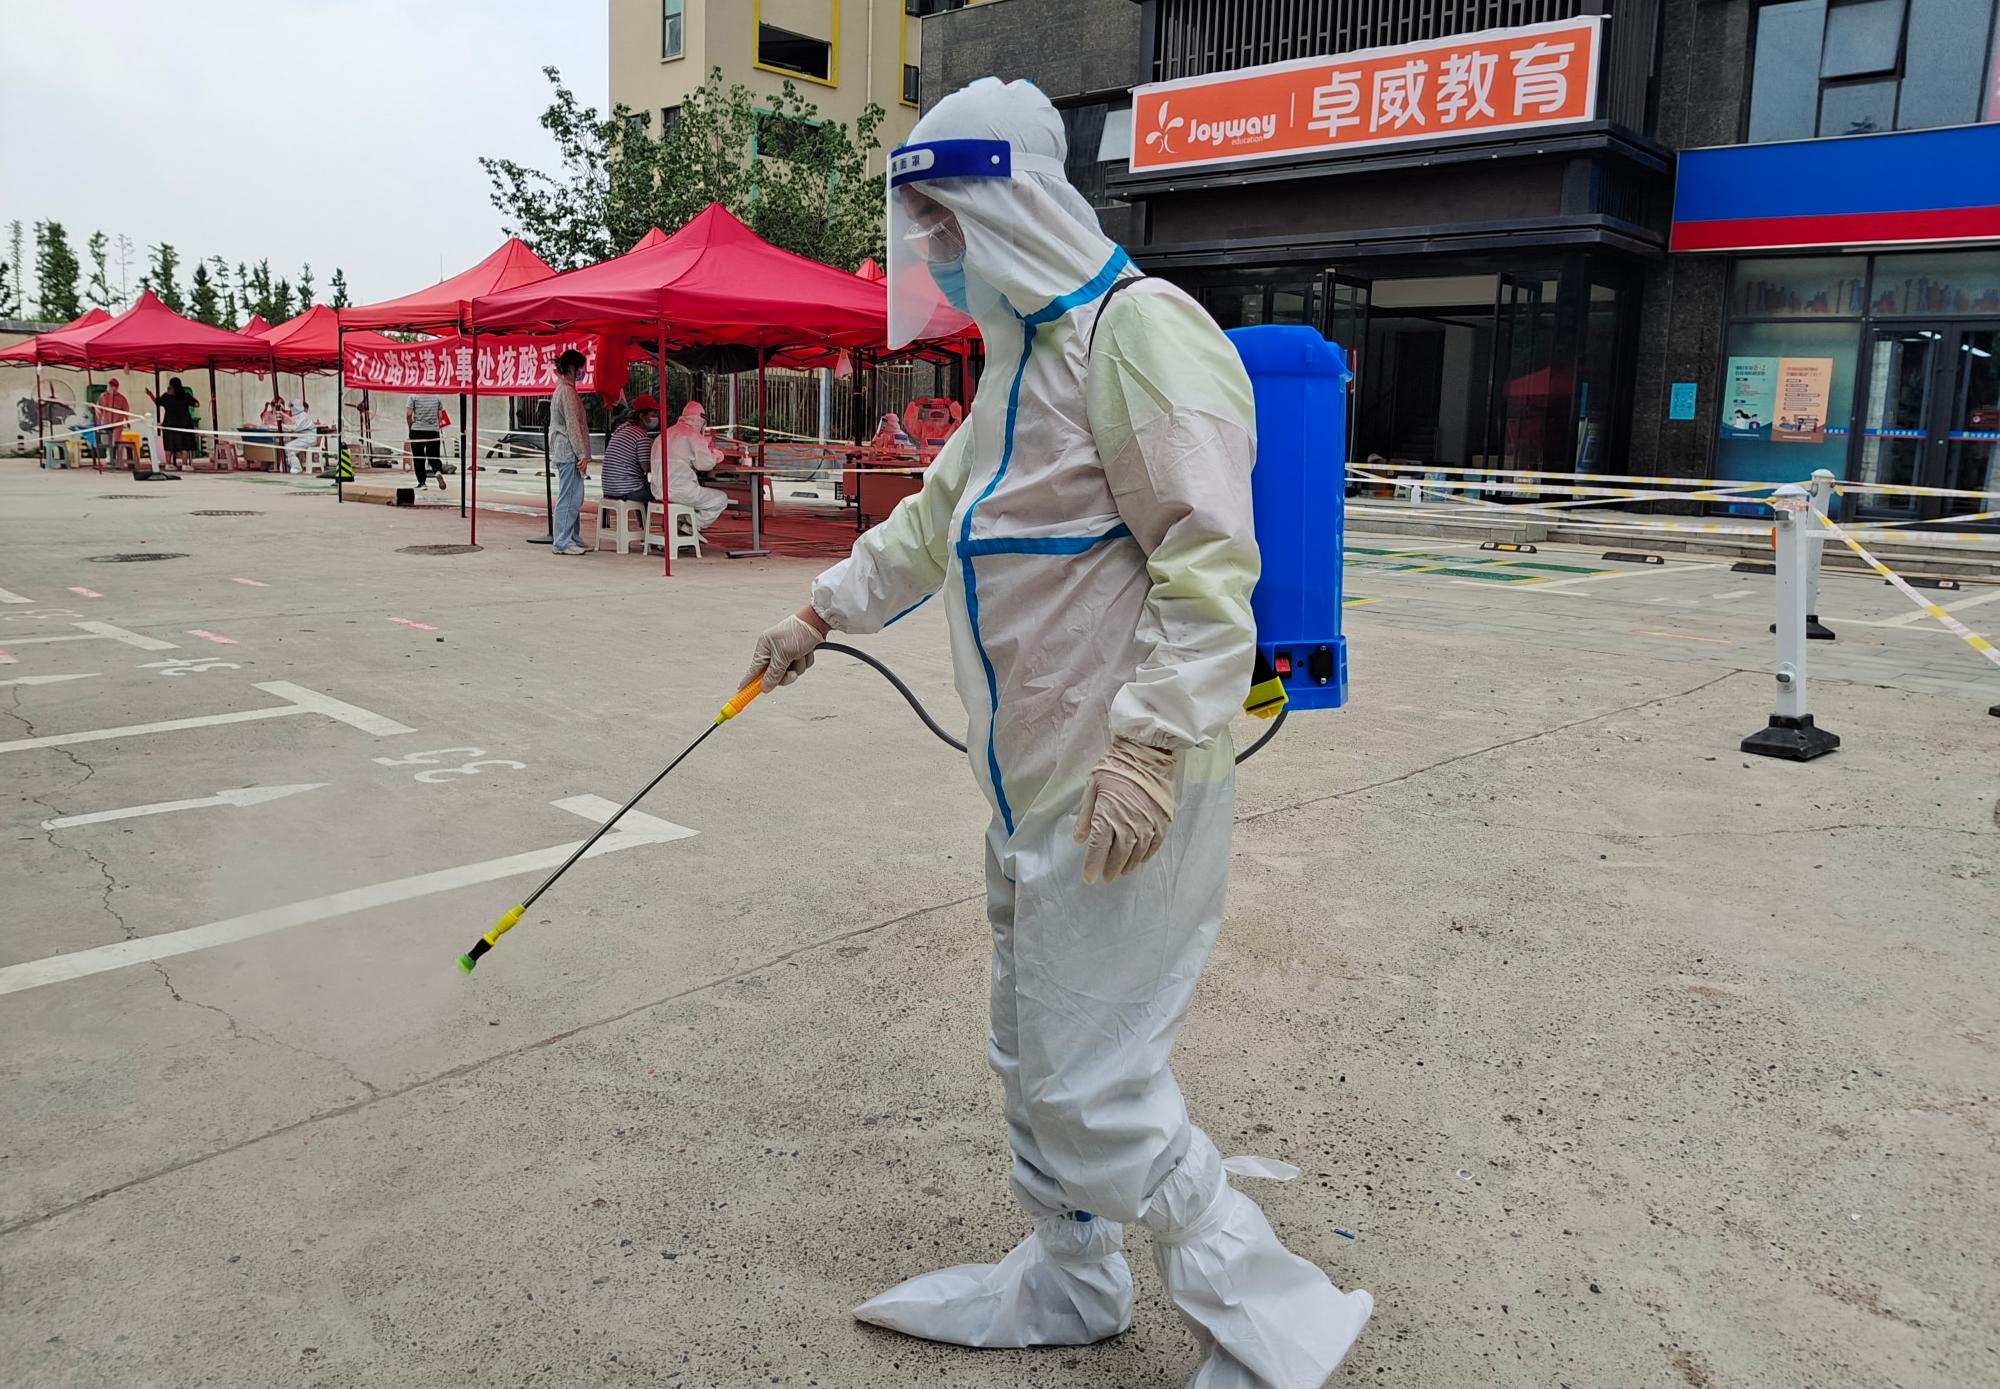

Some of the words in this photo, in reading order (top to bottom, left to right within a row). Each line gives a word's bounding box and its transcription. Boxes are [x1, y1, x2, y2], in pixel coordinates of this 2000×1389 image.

[1308, 42, 1575, 138] 卓威教育
[1187, 114, 1277, 146] Joyway
[1231, 135, 1264, 146] education
[351, 341, 597, 388] 江山路街道办事处核酸采点
[371, 747, 527, 783] 35
